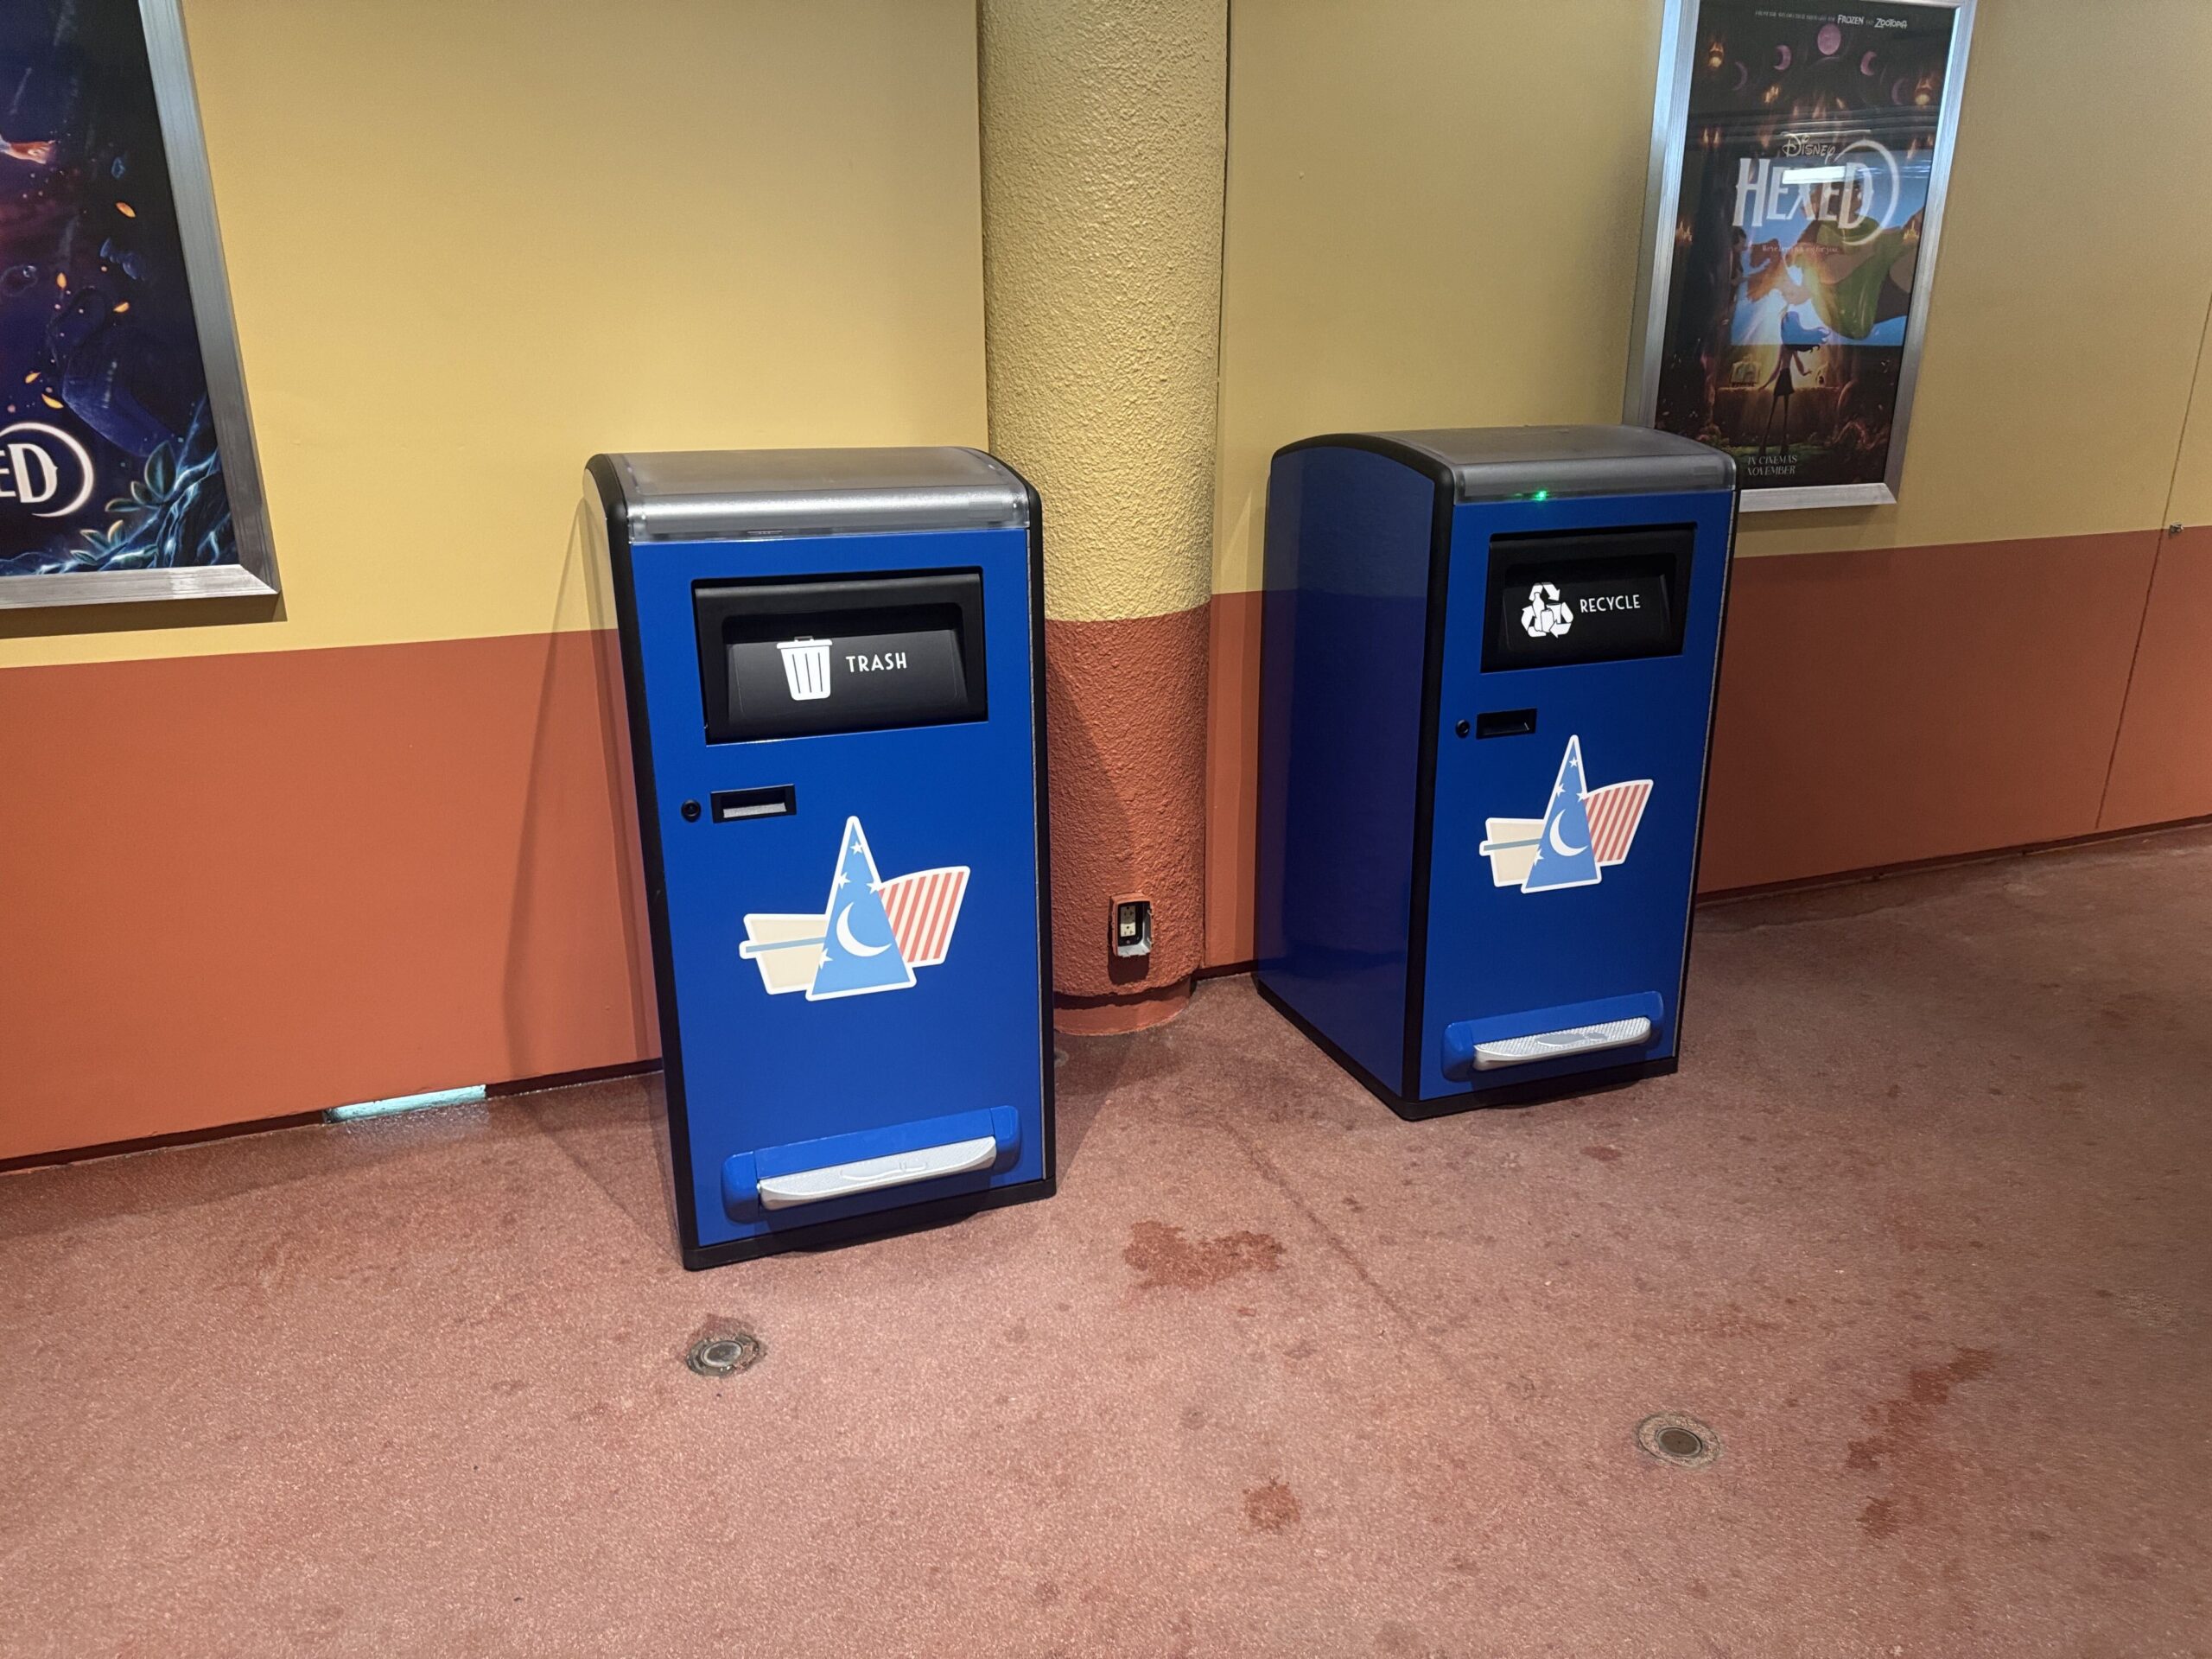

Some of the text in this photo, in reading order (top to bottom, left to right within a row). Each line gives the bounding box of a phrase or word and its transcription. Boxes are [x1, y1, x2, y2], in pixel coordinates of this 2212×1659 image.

[1837, 14, 1865, 25] FROZEN
[1732, 158, 1874, 228] HEXED
[1758, 454, 1797, 464] CINEMAS
[1747, 465, 1796, 475] NOVEMBER
[1580, 594, 1641, 613] RECYCLE
[846, 652, 907, 673] TRASH
